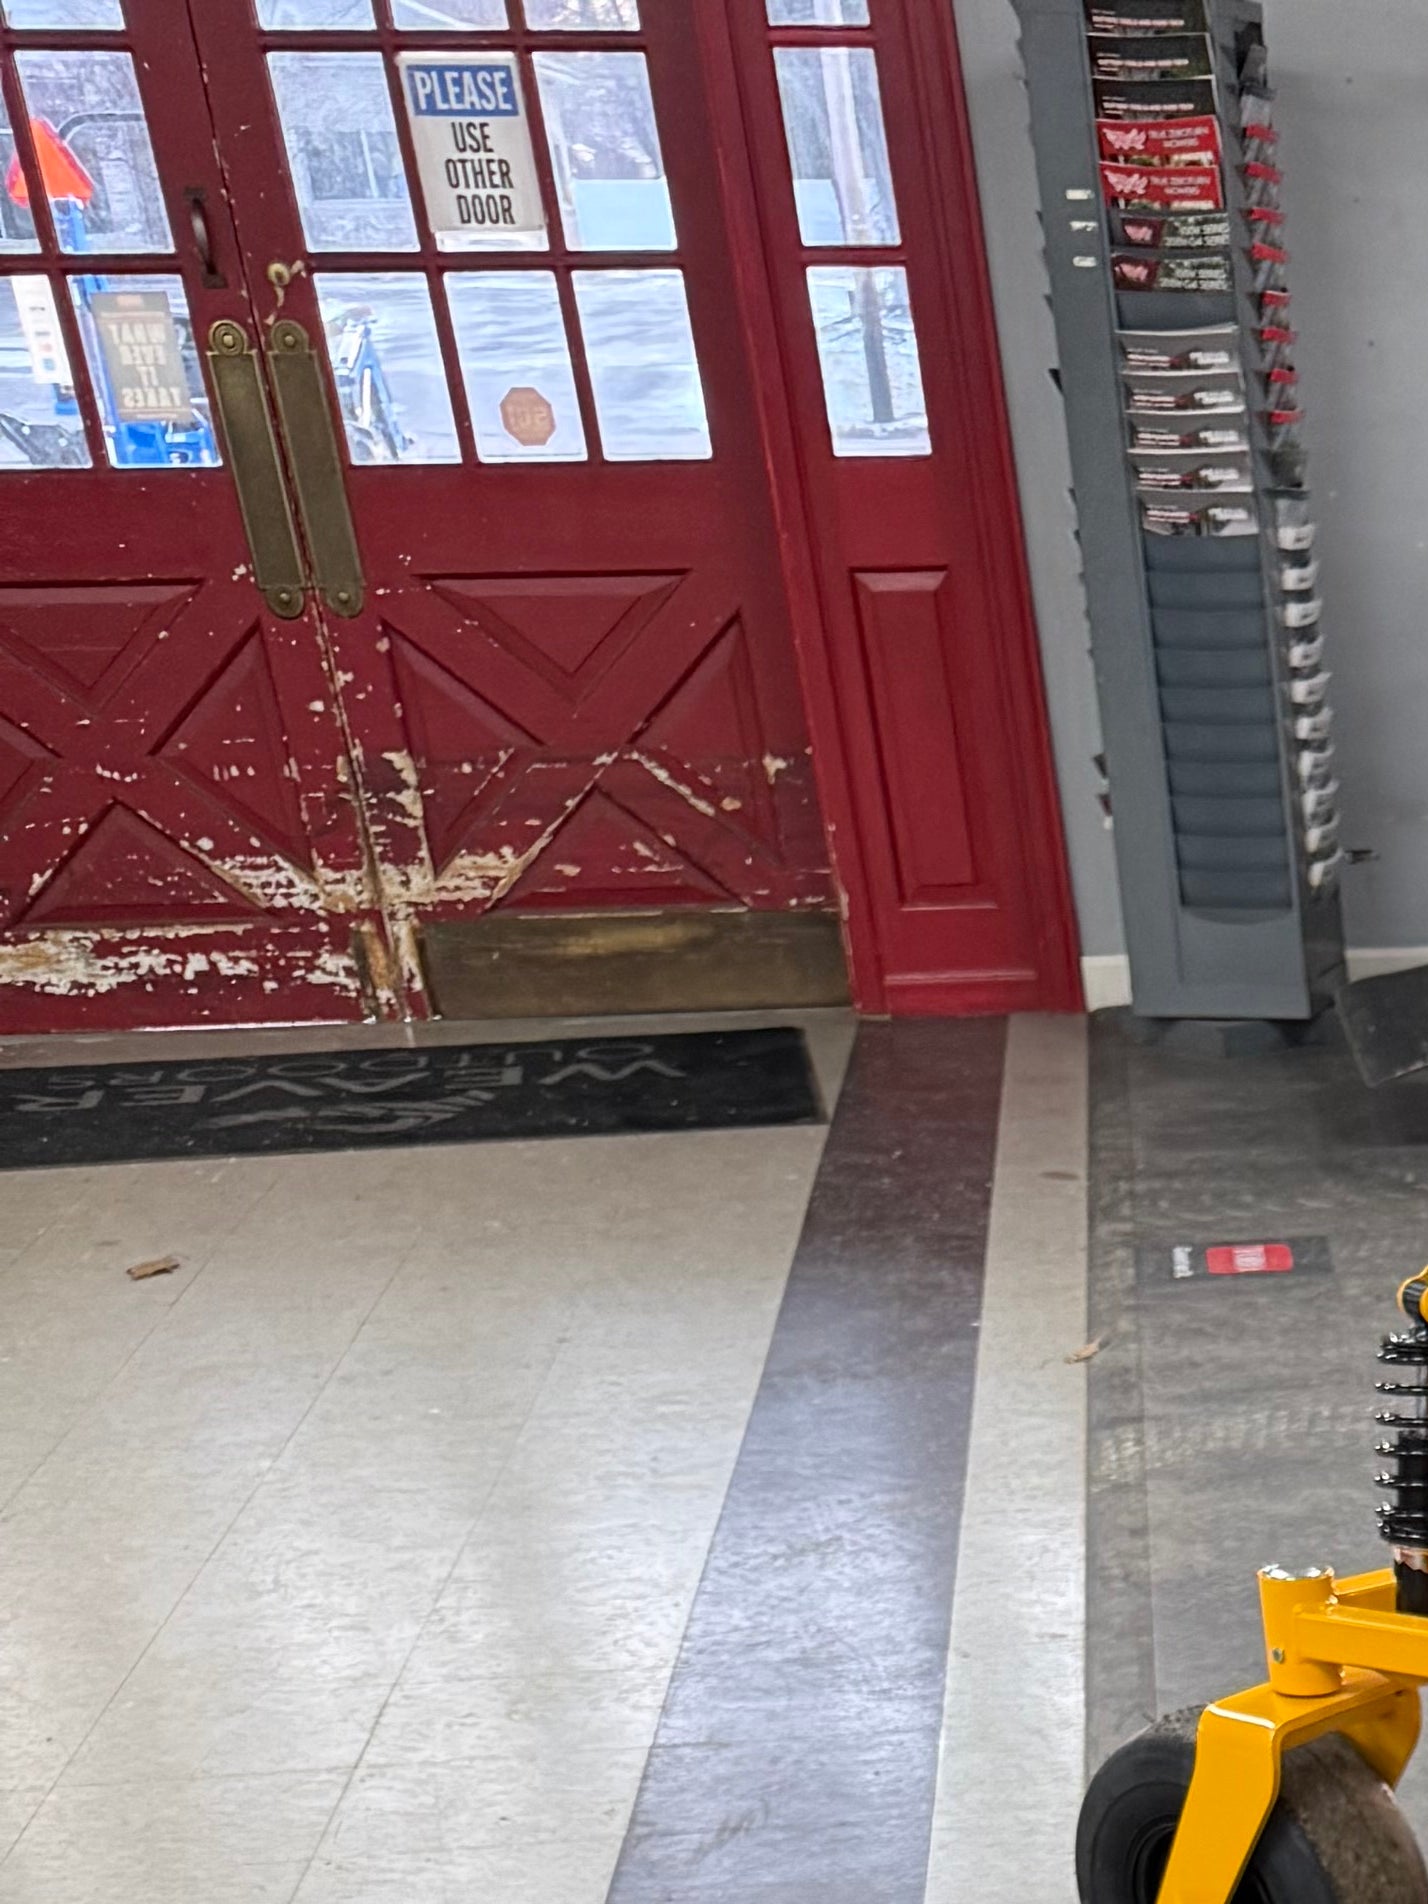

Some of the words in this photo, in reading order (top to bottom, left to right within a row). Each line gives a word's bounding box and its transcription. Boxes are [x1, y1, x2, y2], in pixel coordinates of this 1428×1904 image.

[412, 70, 513, 111] PLEASE
[451, 122, 494, 153] USE
[445, 158, 514, 189] OTHER
[456, 194, 516, 225] DOOR
[46, 1044, 654, 1090] OUTDOORS
[13, 1058, 686, 1113] WEAVER
